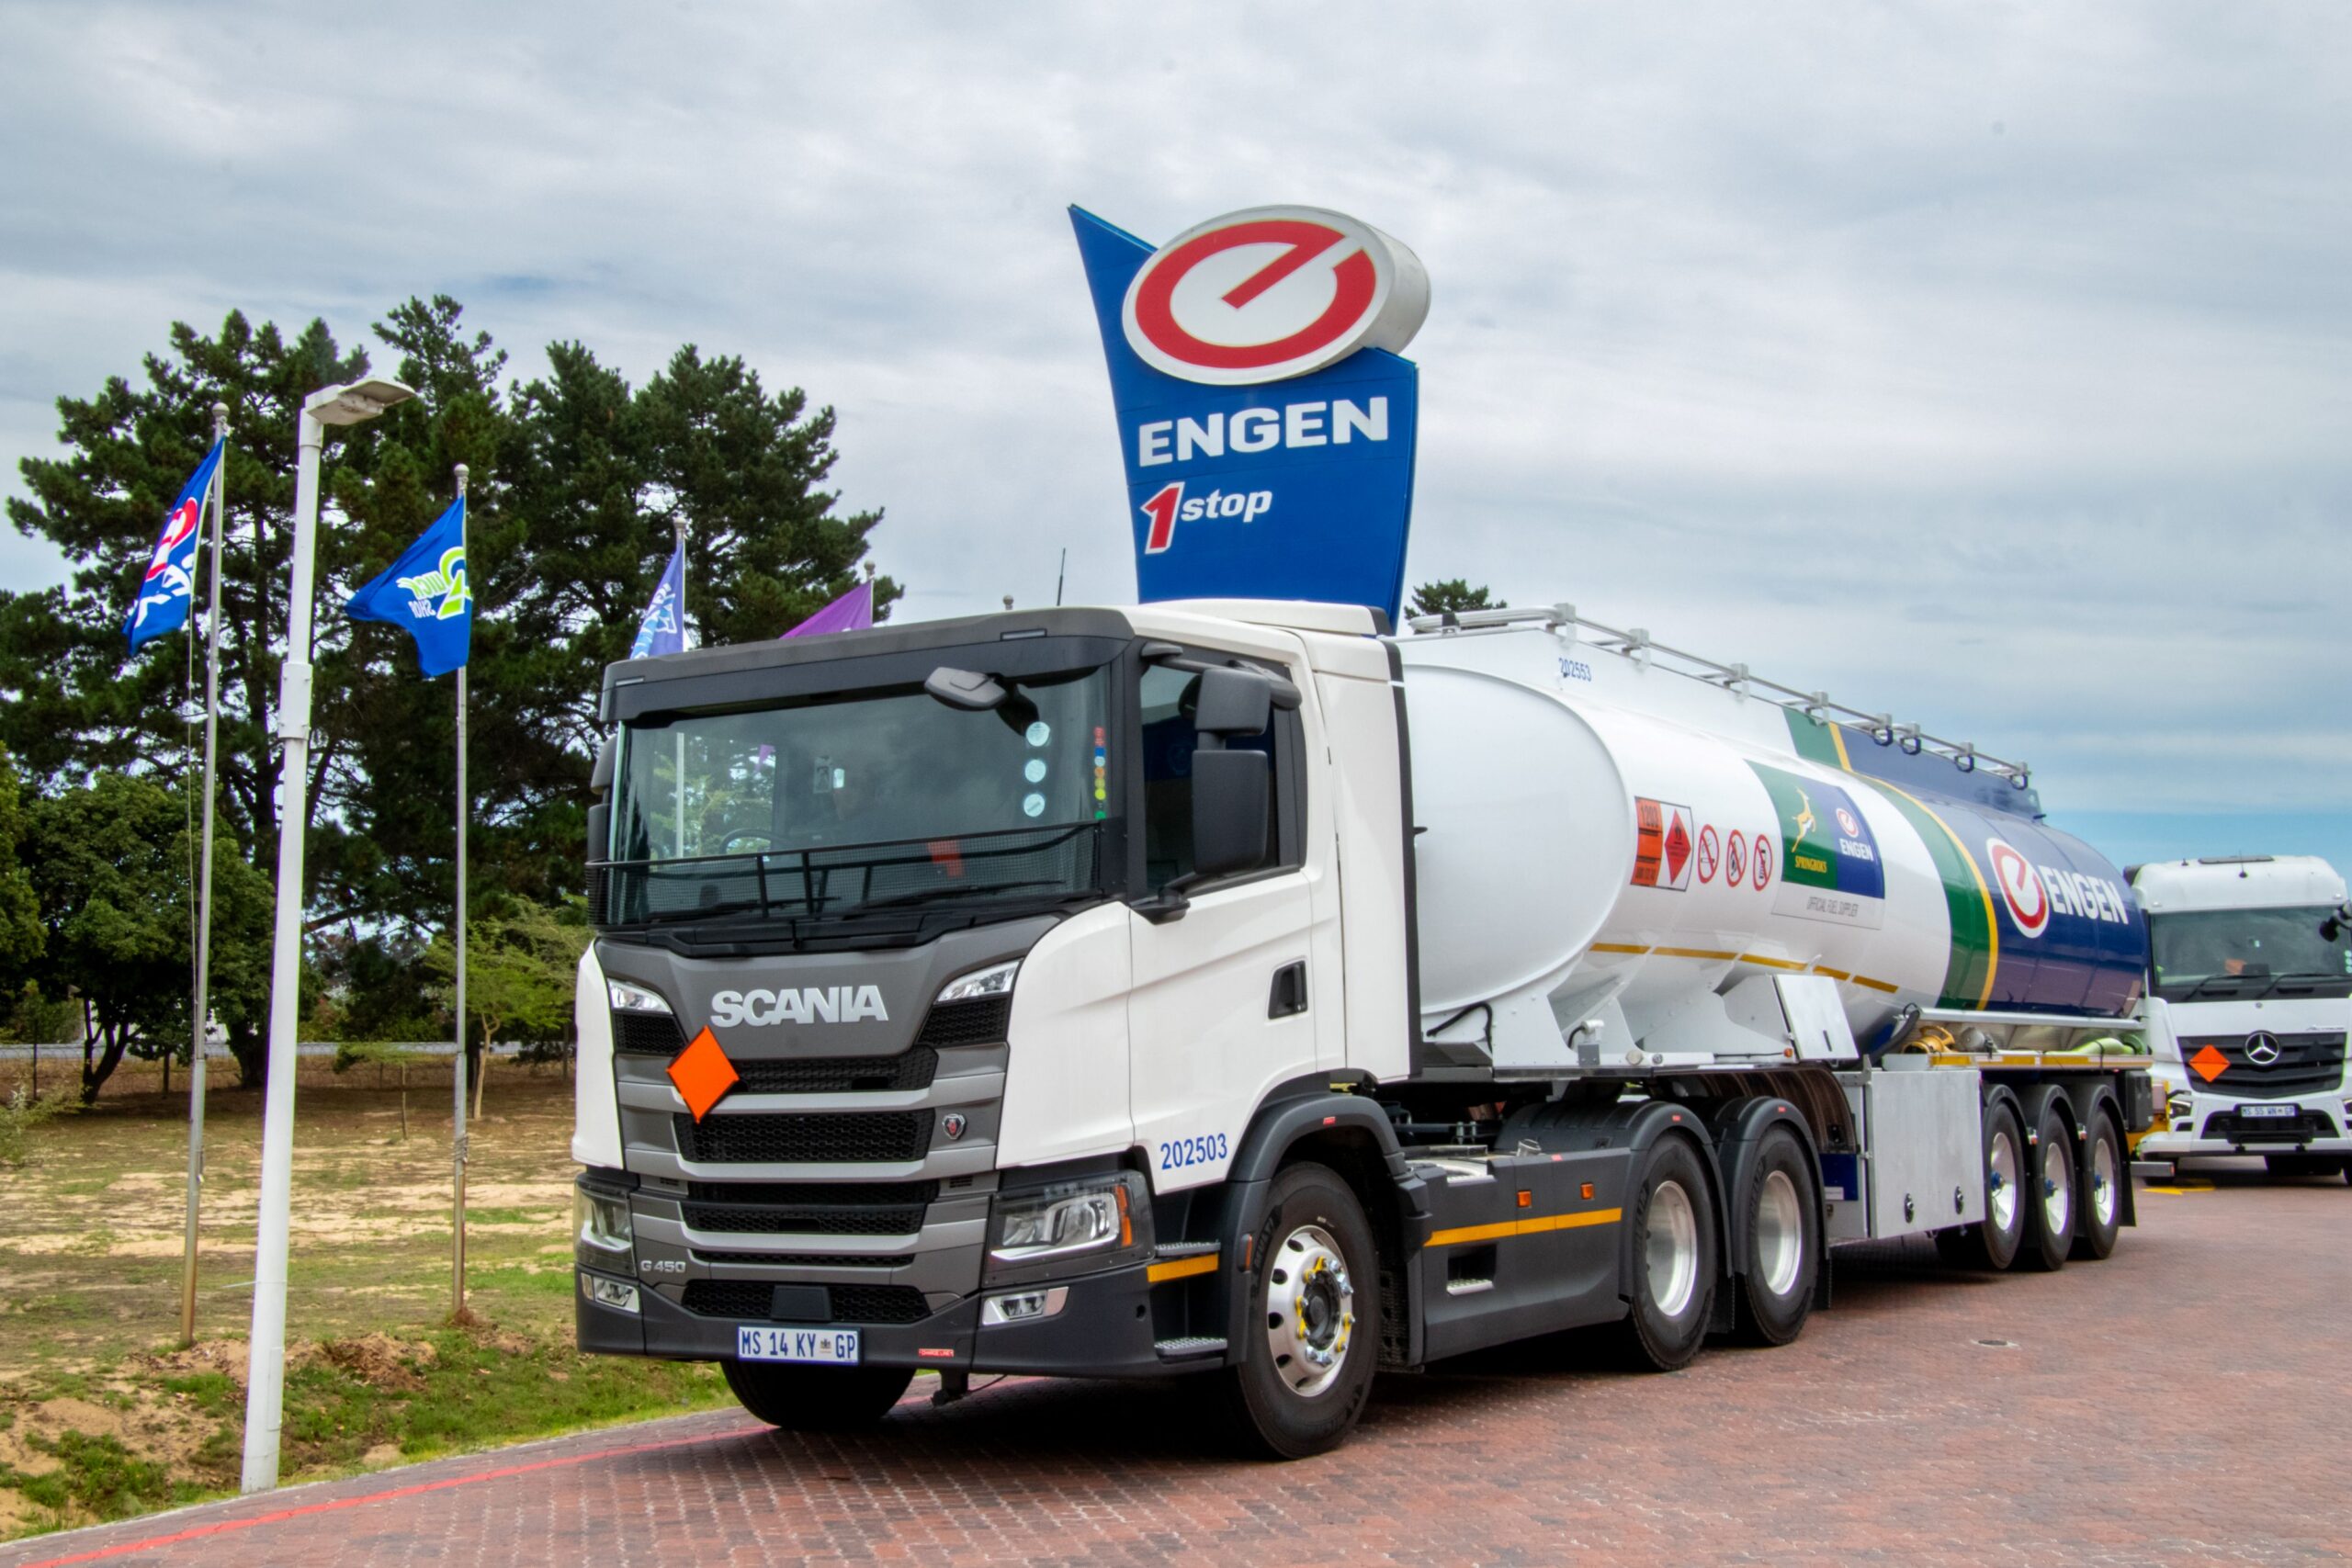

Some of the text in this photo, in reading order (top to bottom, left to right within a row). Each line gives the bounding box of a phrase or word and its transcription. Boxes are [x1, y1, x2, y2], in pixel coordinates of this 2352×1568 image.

[1138, 396, 1388, 468] ENGEN
[1558, 657, 1592, 682] 202553
[1794, 854, 1827, 874] SPRINGBOKS
[1838, 837, 1875, 862] ENGEN
[2037, 864, 2130, 925] ENGEN
[710, 985, 888, 1028] SCANIA
[1160, 1132, 1228, 1169] 202503
[640, 1259, 686, 1274] G 450
[741, 1330, 856, 1359] MS 14 KY GP
